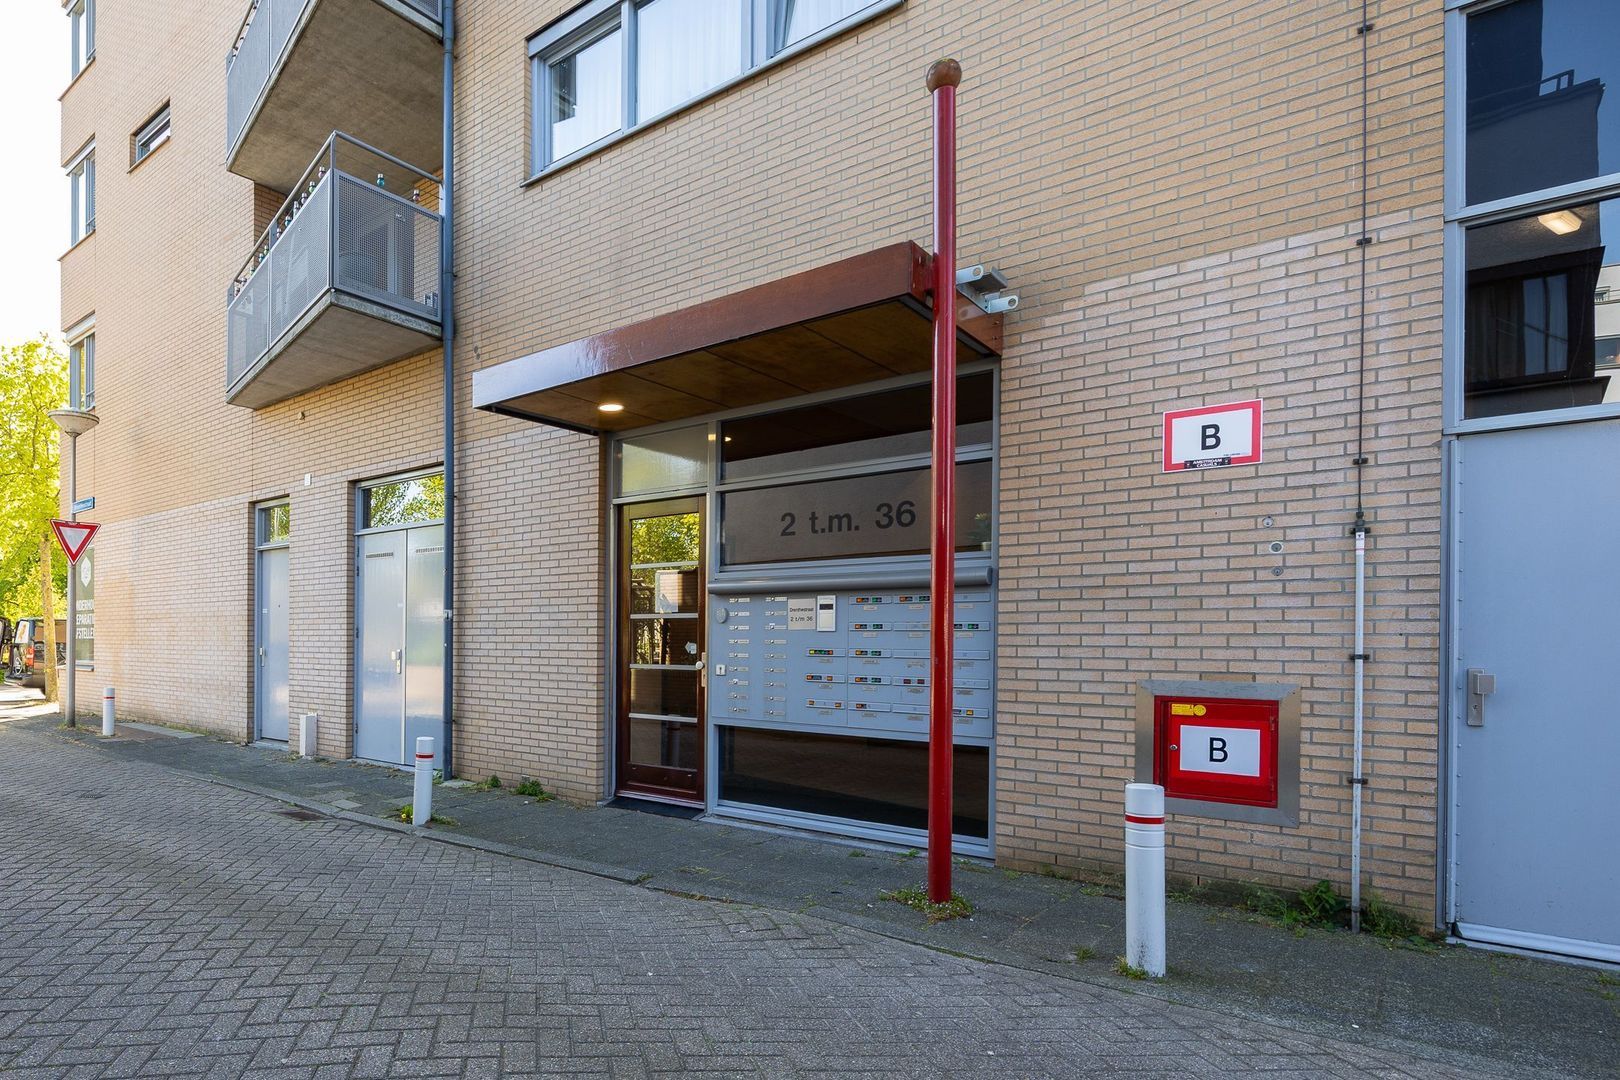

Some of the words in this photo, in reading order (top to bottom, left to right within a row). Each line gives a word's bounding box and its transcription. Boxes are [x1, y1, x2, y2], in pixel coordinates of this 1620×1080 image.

[1201, 423, 1221, 451] B
[780, 512, 796, 536] 2
[809, 511, 860, 534] t.m.
[875, 500, 916, 529] 36
[1208, 737, 1228, 763] B
